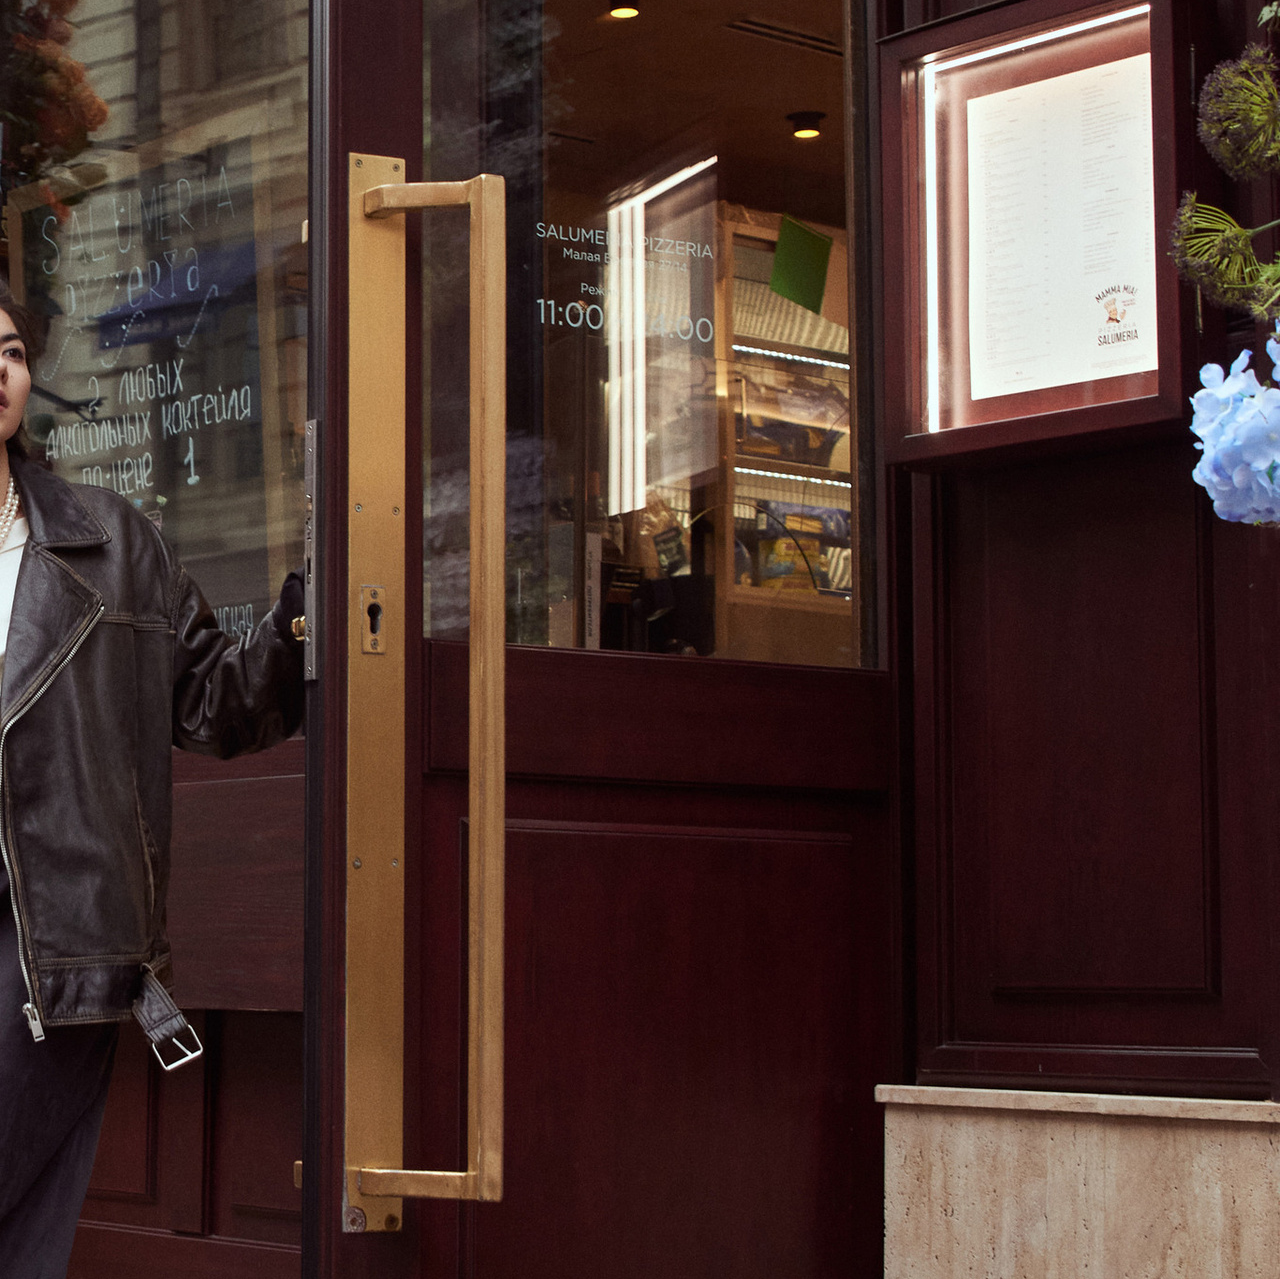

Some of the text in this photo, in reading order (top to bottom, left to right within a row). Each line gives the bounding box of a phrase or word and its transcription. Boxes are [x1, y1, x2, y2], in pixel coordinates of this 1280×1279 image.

[563, 248, 601, 263] Малая
[1095, 284, 1121, 303] MAMMA
[537, 298, 714, 343] 11:00 4:00
[1097, 329, 1139, 346] SALUMERIA
[184, 436, 200, 485] 1
